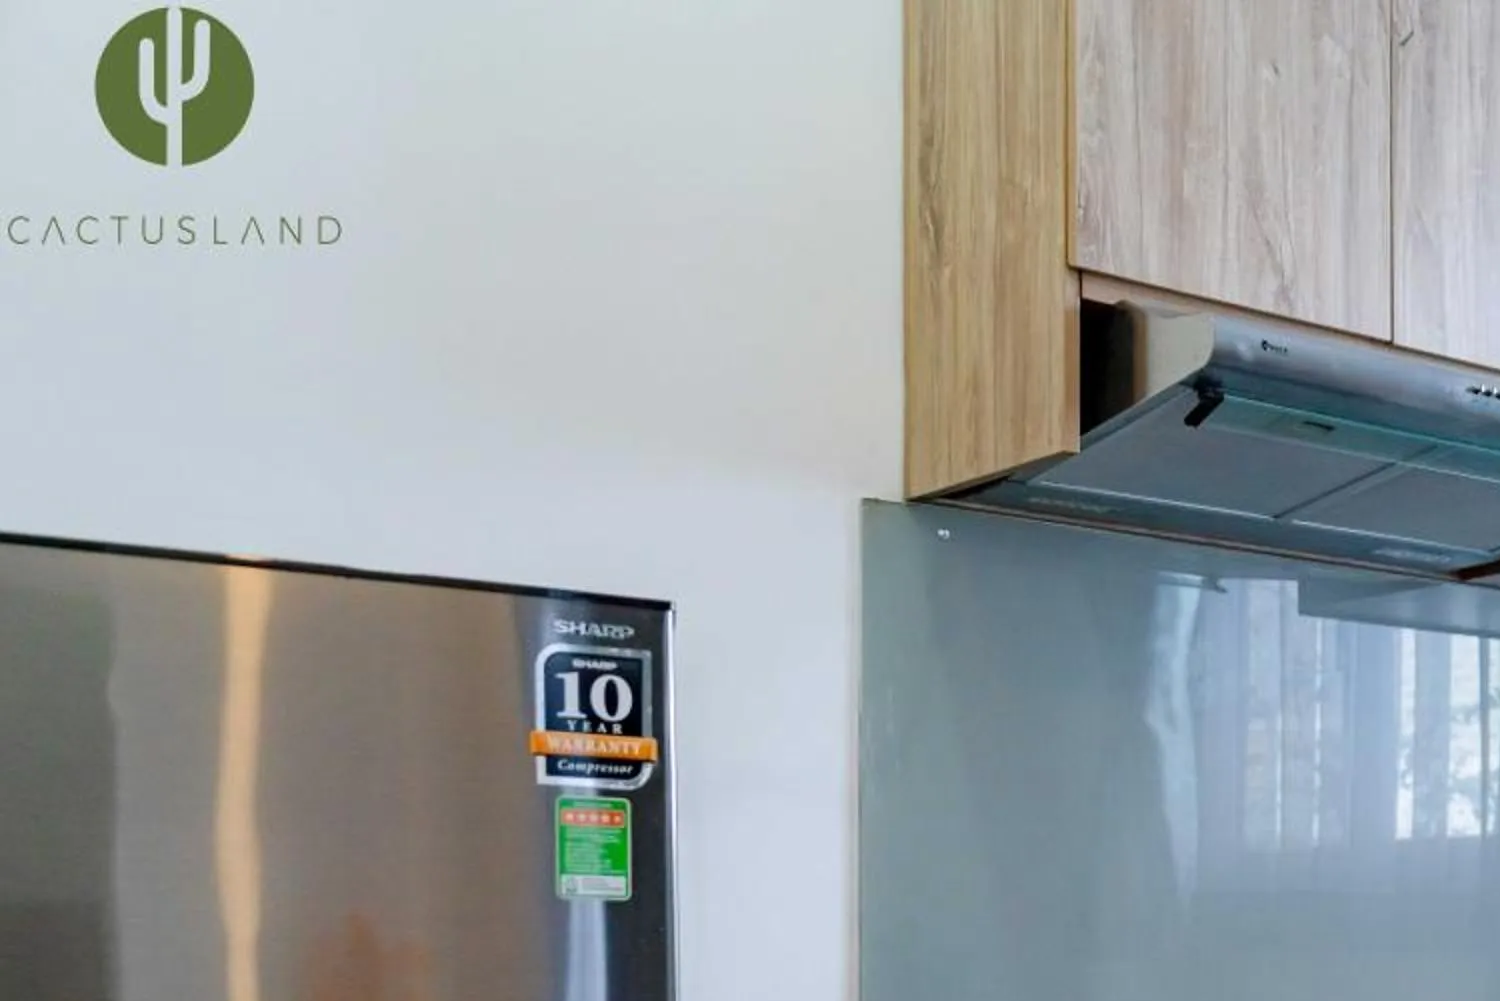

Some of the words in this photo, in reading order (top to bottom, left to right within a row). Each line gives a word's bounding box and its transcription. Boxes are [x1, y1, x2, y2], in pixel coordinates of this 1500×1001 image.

[552, 619, 635, 639] SHARP
[554, 671, 633, 722] 10
[567, 719, 623, 735] YEAR
[547, 736, 641, 756] WARRANTY
[557, 757, 634, 775] Compressor
